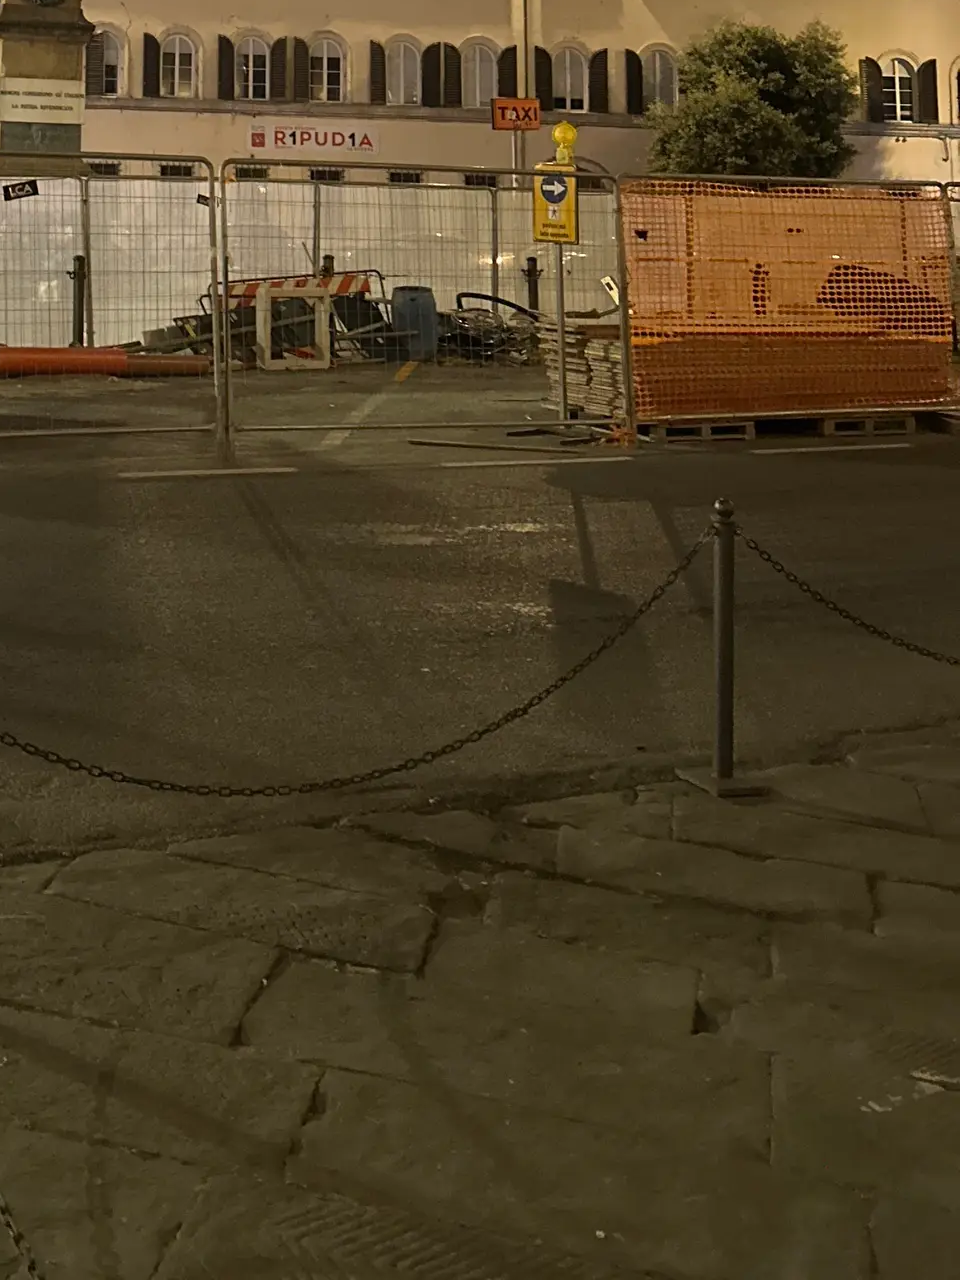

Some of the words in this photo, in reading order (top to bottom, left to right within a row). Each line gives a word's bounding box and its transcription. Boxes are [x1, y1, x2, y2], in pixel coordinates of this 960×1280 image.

[497, 106, 538, 121] TAXI
[274, 130, 373, 148] R1PUD1A
[8, 183, 34, 198] LCA
